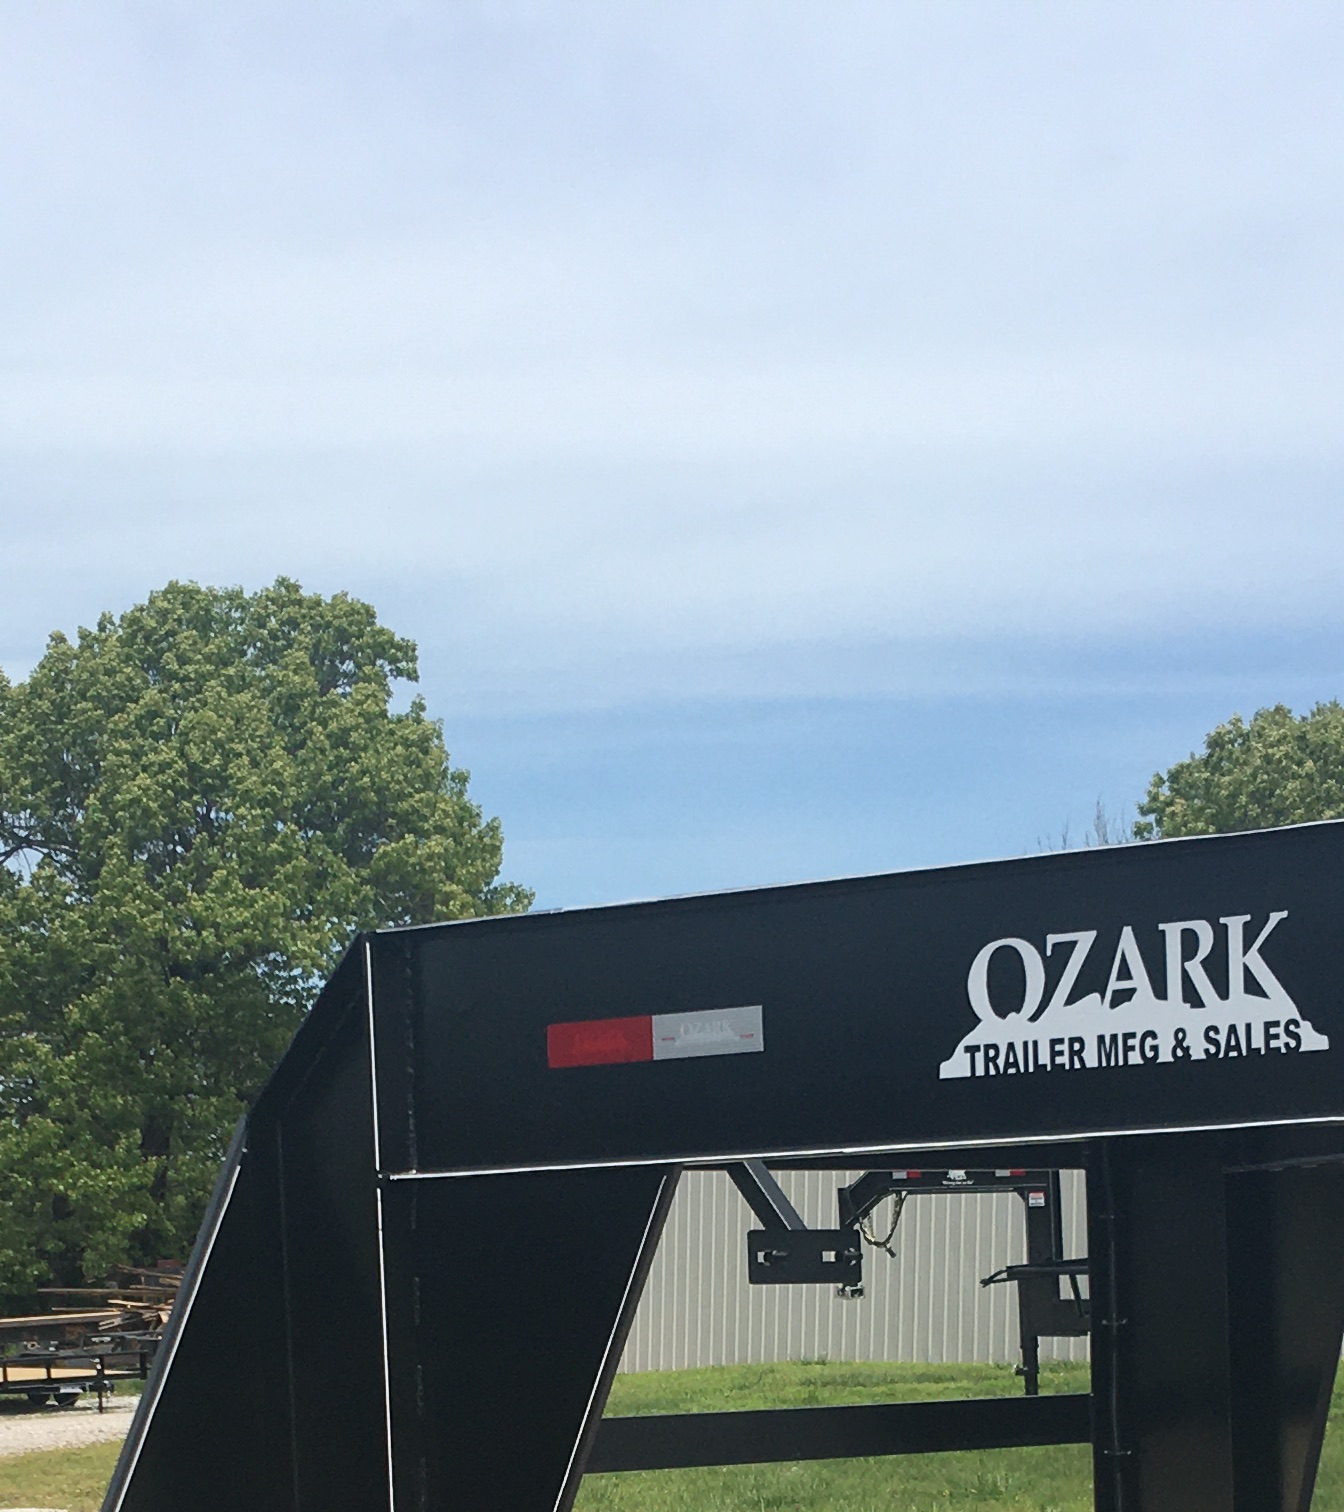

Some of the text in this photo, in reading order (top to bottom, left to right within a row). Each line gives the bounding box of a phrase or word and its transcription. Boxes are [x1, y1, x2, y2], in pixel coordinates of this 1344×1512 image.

[967, 910, 1294, 1023] OZARK
[964, 1018, 1302, 1077] TRAILER MFG & SALES
